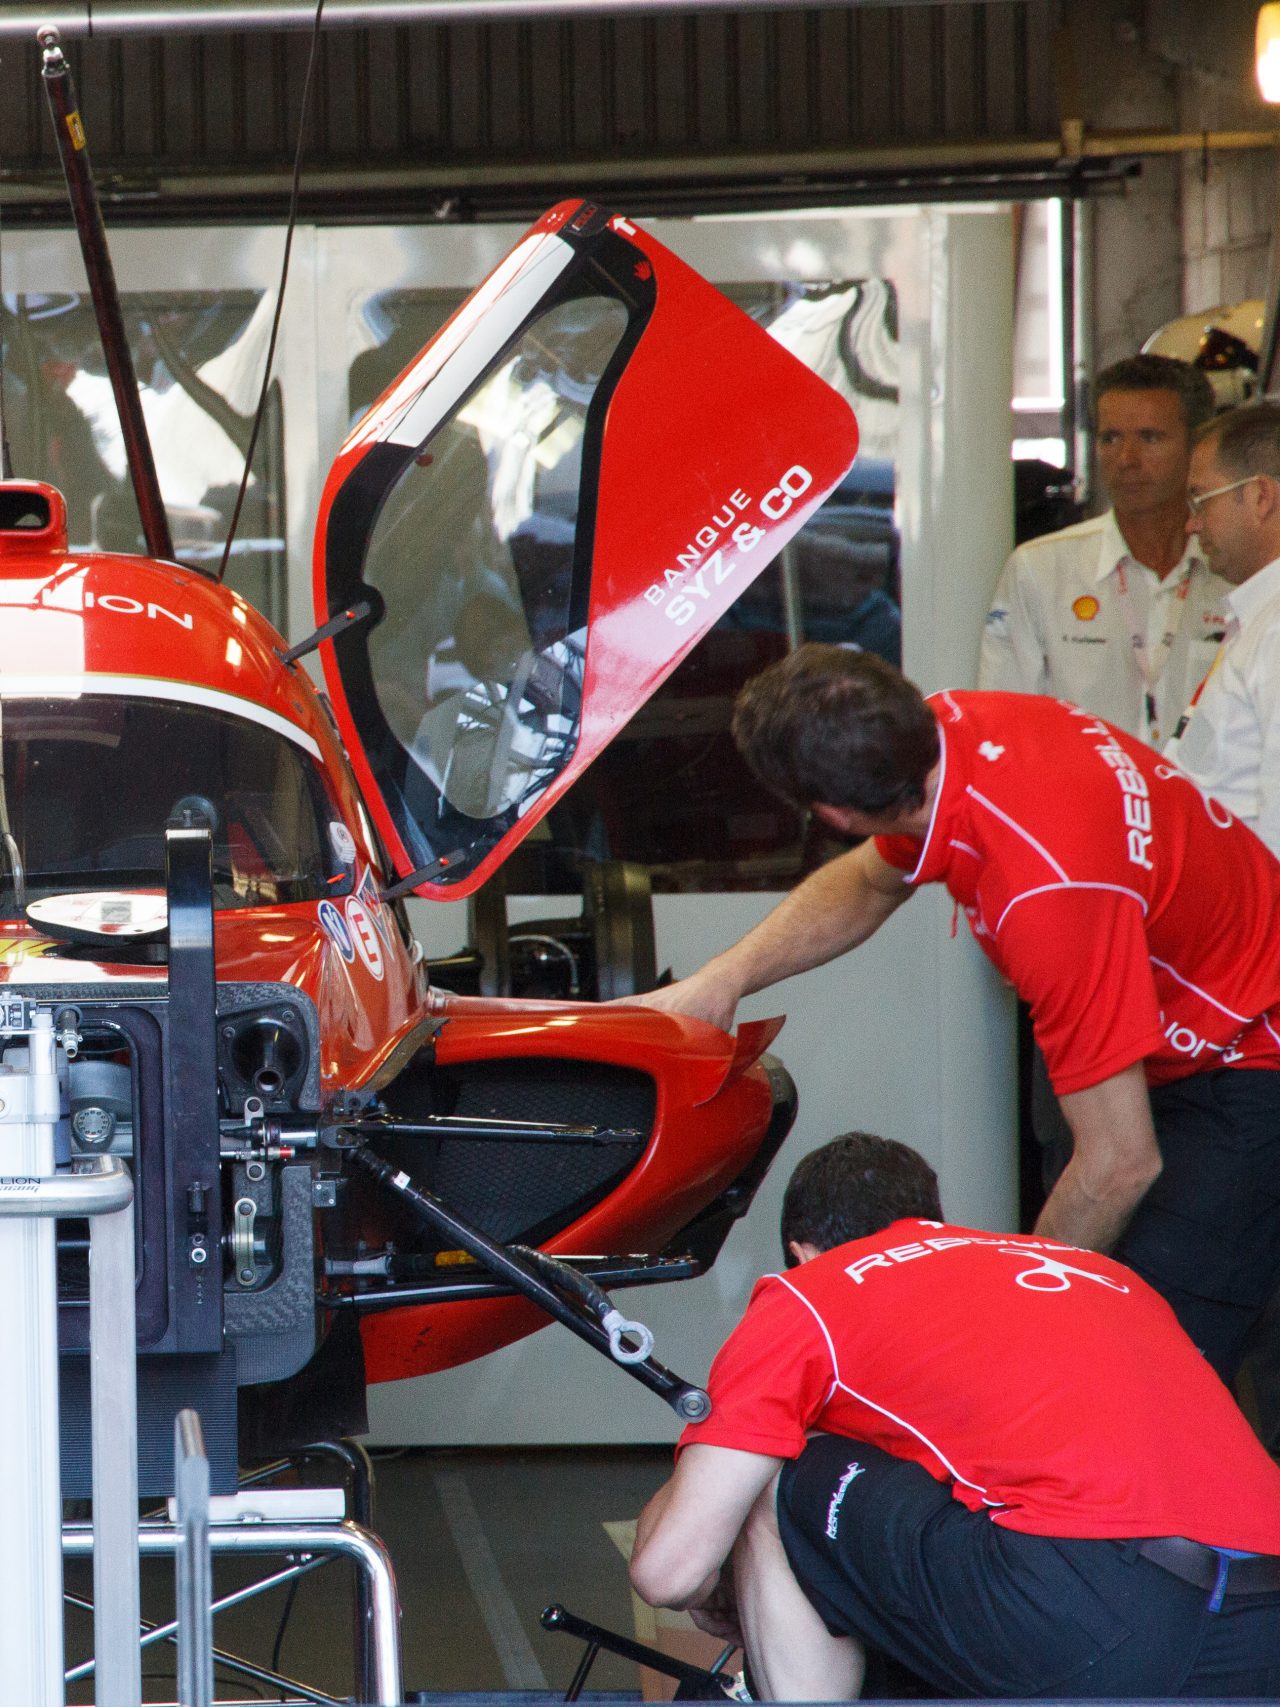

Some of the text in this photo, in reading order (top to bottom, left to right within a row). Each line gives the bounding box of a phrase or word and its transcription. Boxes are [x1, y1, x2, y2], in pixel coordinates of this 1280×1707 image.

[643, 488, 752, 607] BANQUE
[665, 464, 813, 626] SYZ & CO
